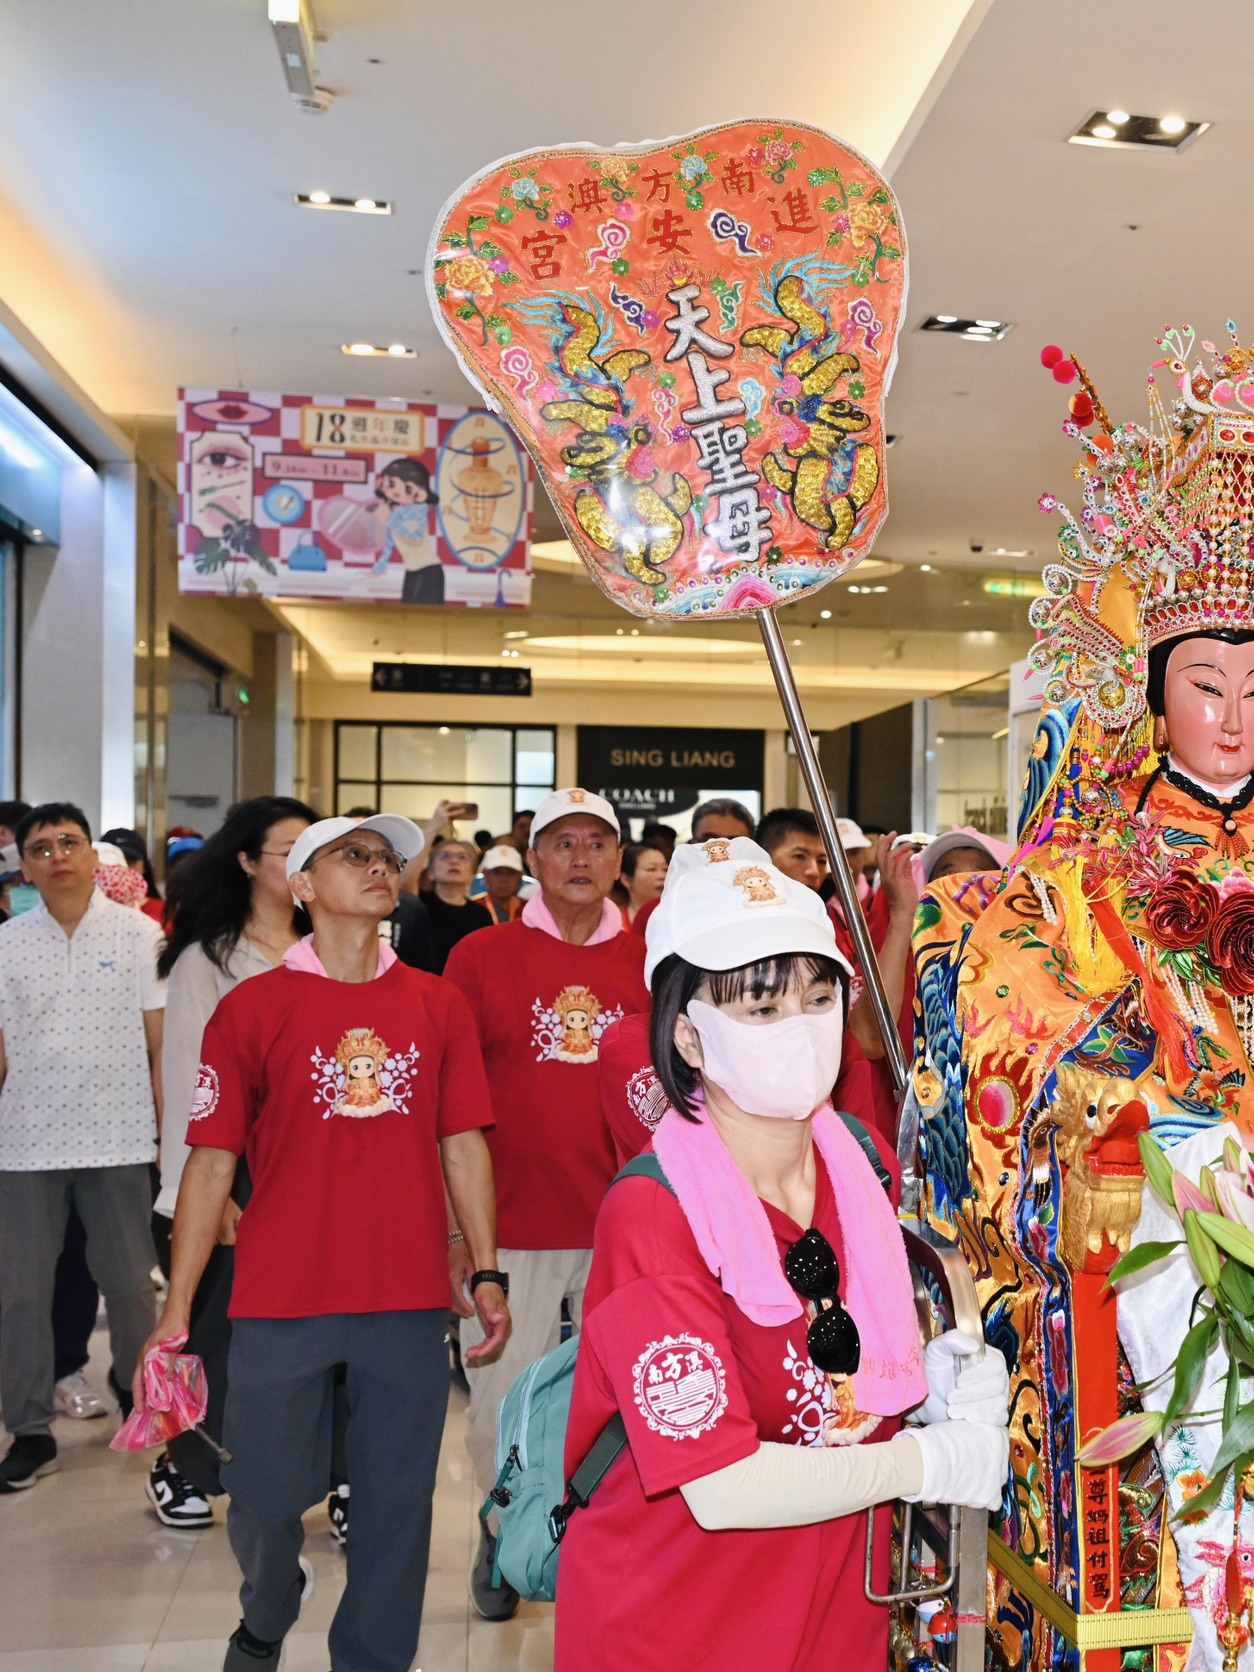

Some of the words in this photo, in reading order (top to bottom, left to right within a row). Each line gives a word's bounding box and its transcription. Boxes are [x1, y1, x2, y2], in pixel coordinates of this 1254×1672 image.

[664, 284, 774, 562] 天上聖母
[610, 748, 664, 767] SING
[670, 750, 736, 768] LIANG
[599, 787, 675, 803] COACH
